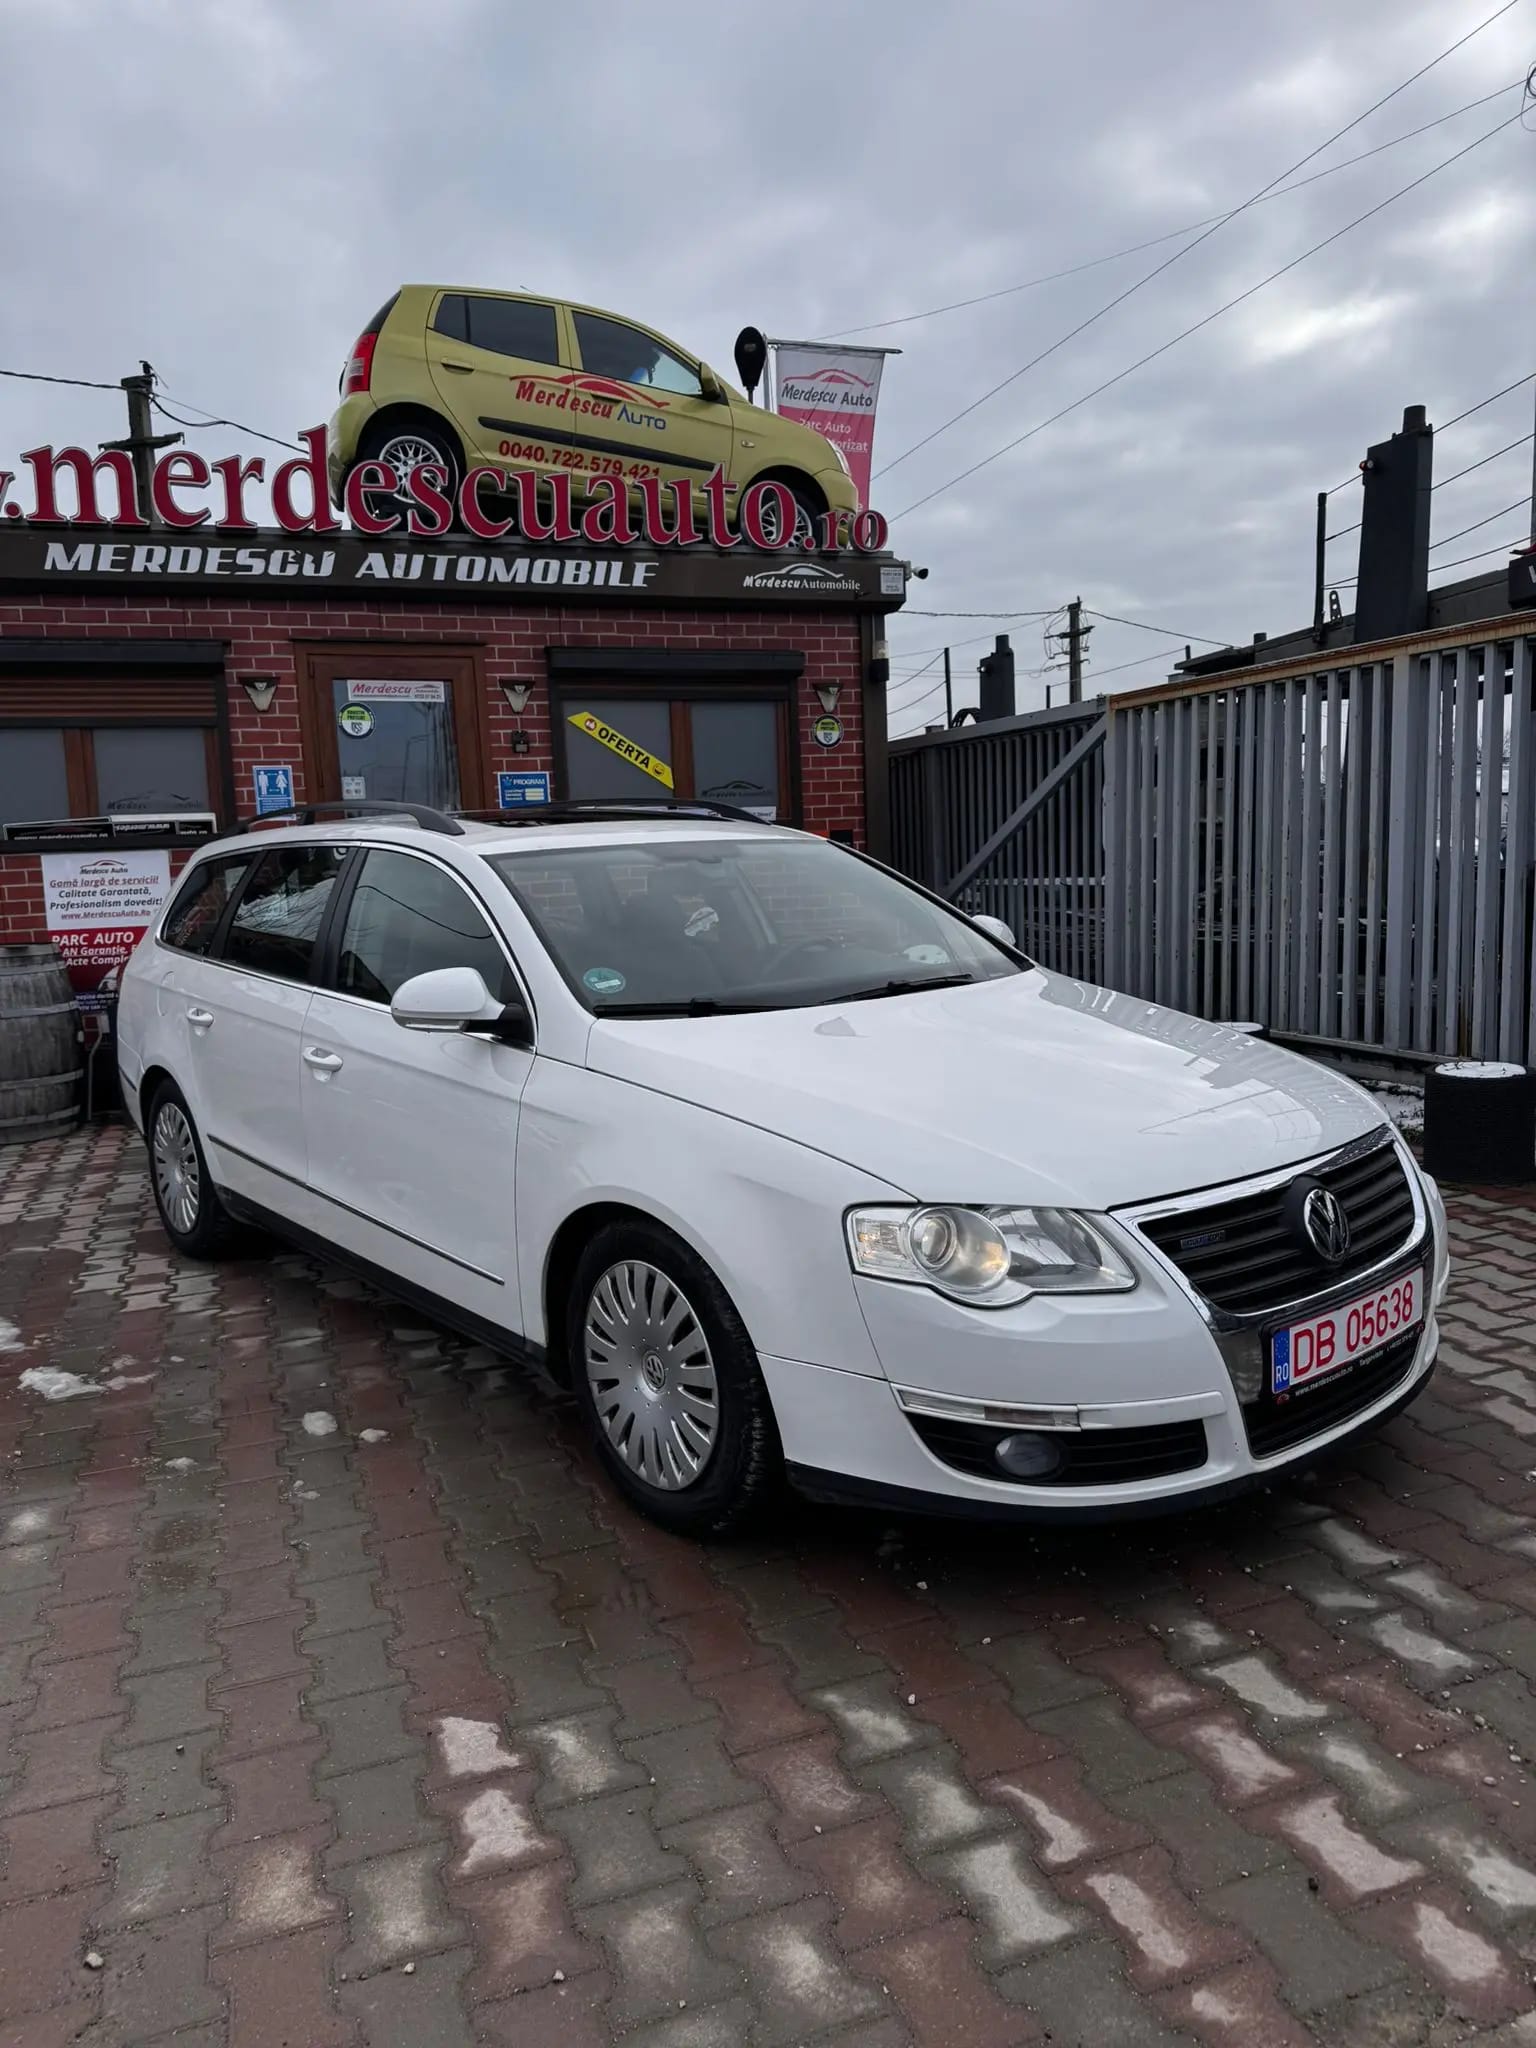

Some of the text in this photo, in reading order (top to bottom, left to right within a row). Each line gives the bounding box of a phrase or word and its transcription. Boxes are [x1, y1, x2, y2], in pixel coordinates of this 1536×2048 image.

[515, 381, 615, 419] Merdescu
[782, 383, 873, 408] Merdescu Auto
[824, 421, 852, 434] Auto
[833, 438, 868, 452] orizat
[44, 543, 660, 587] MERDESCU AUTOMOBILE
[352, 683, 412, 694] Merdescu
[598, 727, 651, 769] OFERTA
[50, 878, 78, 889] Gamă
[108, 876, 120, 886] de
[122, 875, 159, 885] servicii!
[59, 888, 97, 899] Calitate
[50, 897, 163, 911] Profesionalism dovedit!
[52, 931, 135, 946] PARC AUTO
[62, 947, 78, 957] AN
[66, 957, 88, 966] Acte
[1293, 1280, 1413, 1379] DB 05638
[1275, 1362, 1290, 1384] RO
